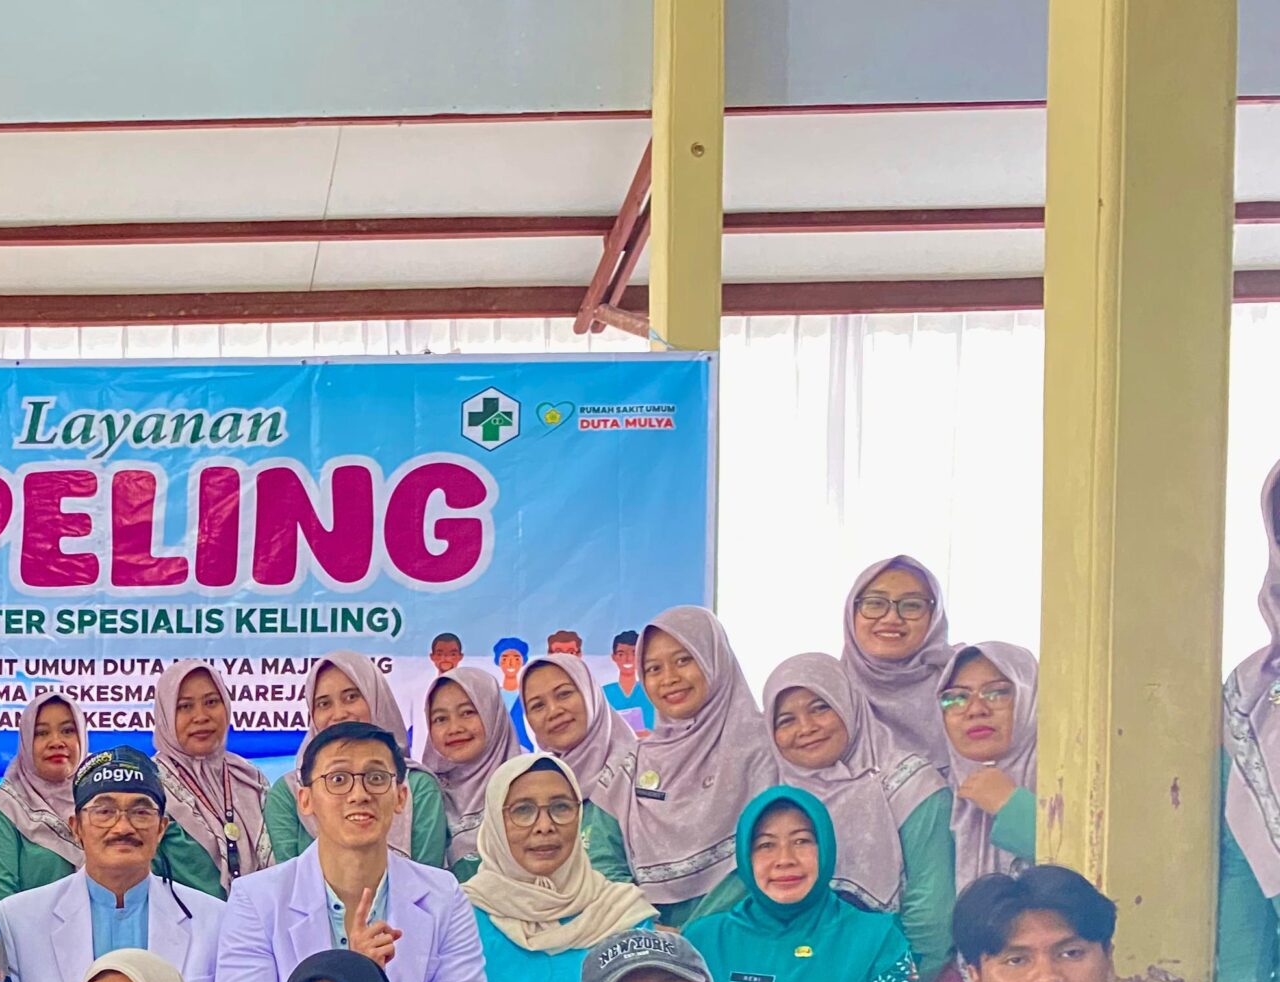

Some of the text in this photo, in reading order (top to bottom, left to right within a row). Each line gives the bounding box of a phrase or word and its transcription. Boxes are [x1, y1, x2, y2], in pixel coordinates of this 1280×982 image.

[22, 401, 283, 457] Layanan
[580, 418, 673, 429] DUTA MULYA
[57, 609, 224, 635] SPESIALIS
[237, 607, 402, 637] KELILING)
[25, 659, 95, 676] UMUM
[104, 659, 164, 676] DUTA
[93, 767, 144, 782] obgyn
[599, 936, 677, 968] NEW YORK
